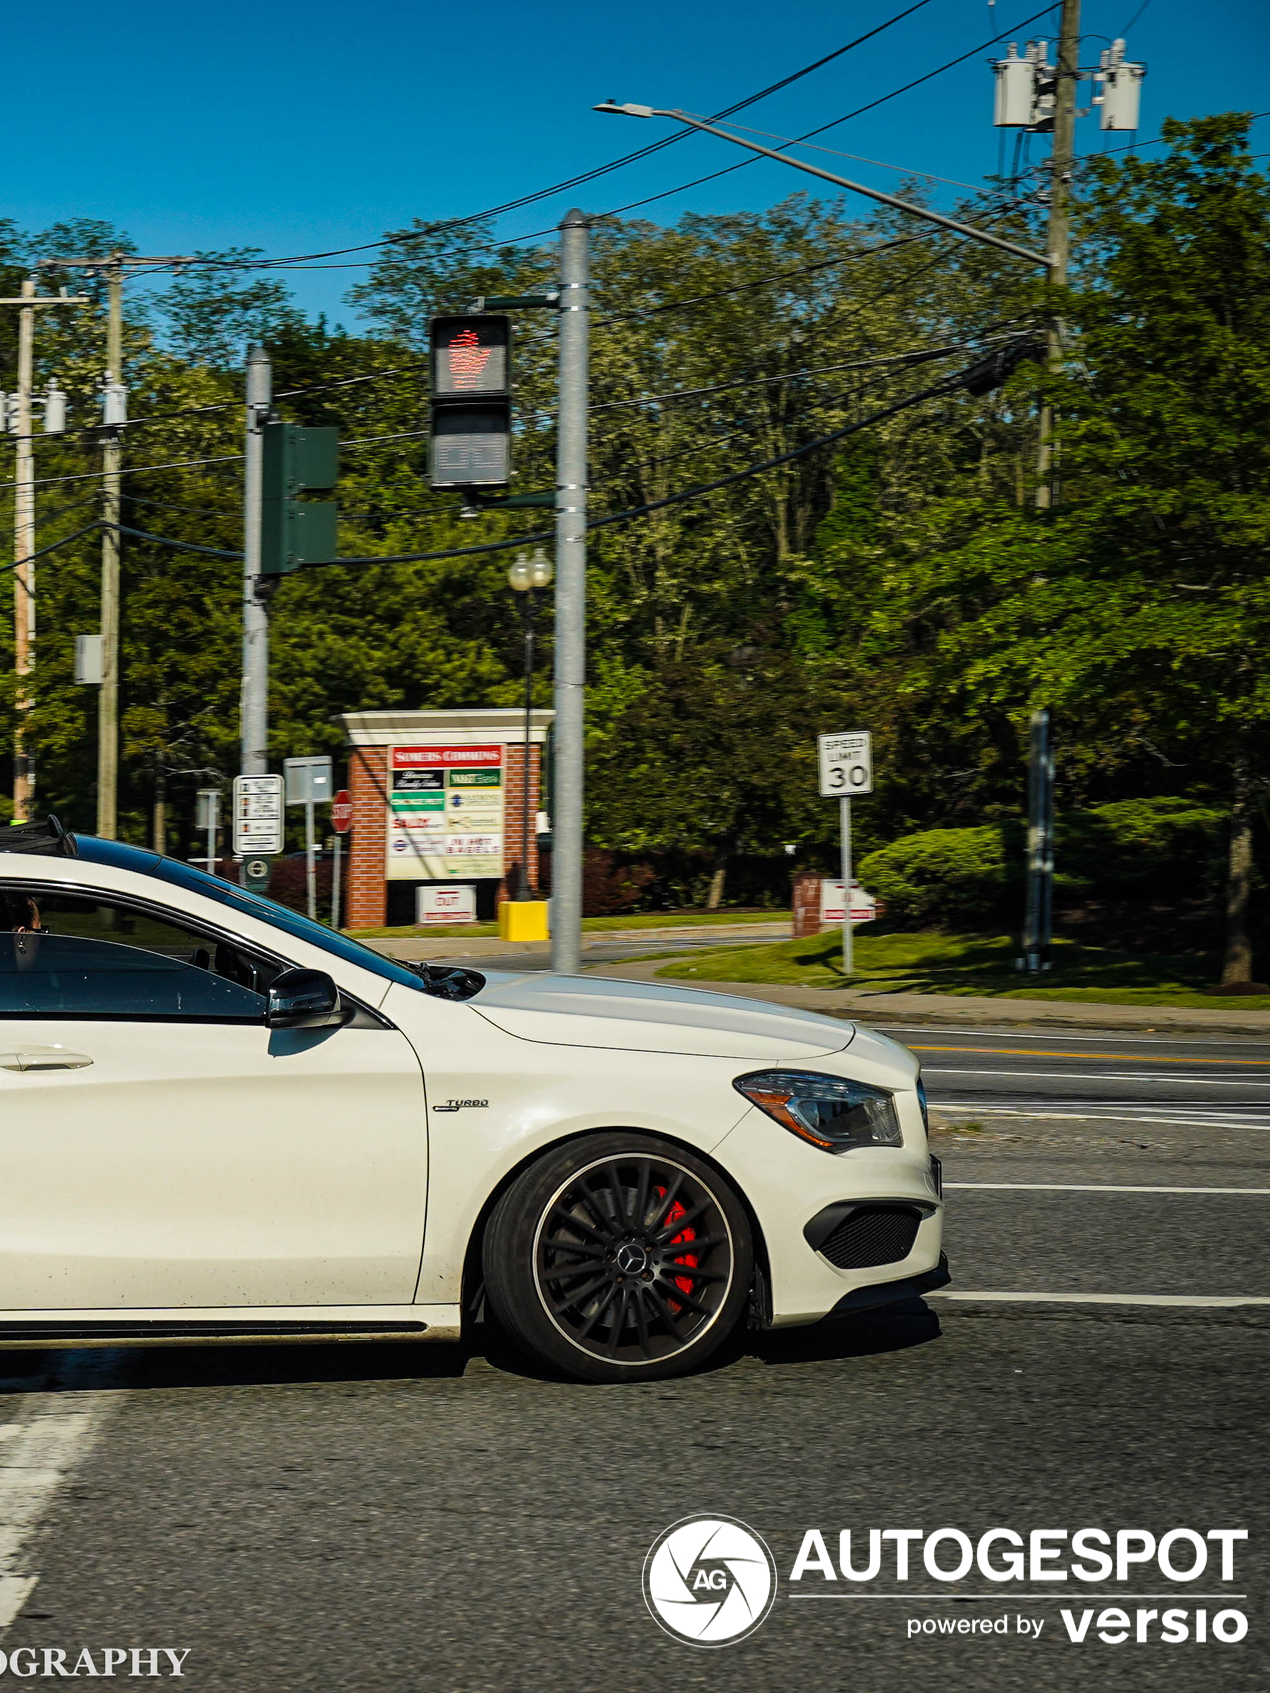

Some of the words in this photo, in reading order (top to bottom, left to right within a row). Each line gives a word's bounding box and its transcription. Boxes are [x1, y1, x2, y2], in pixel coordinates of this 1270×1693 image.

[823, 738, 868, 750] SPEED
[828, 751, 862, 762] LIMIT
[829, 765, 868, 788] 30
[331, 803, 352, 819] STOP
